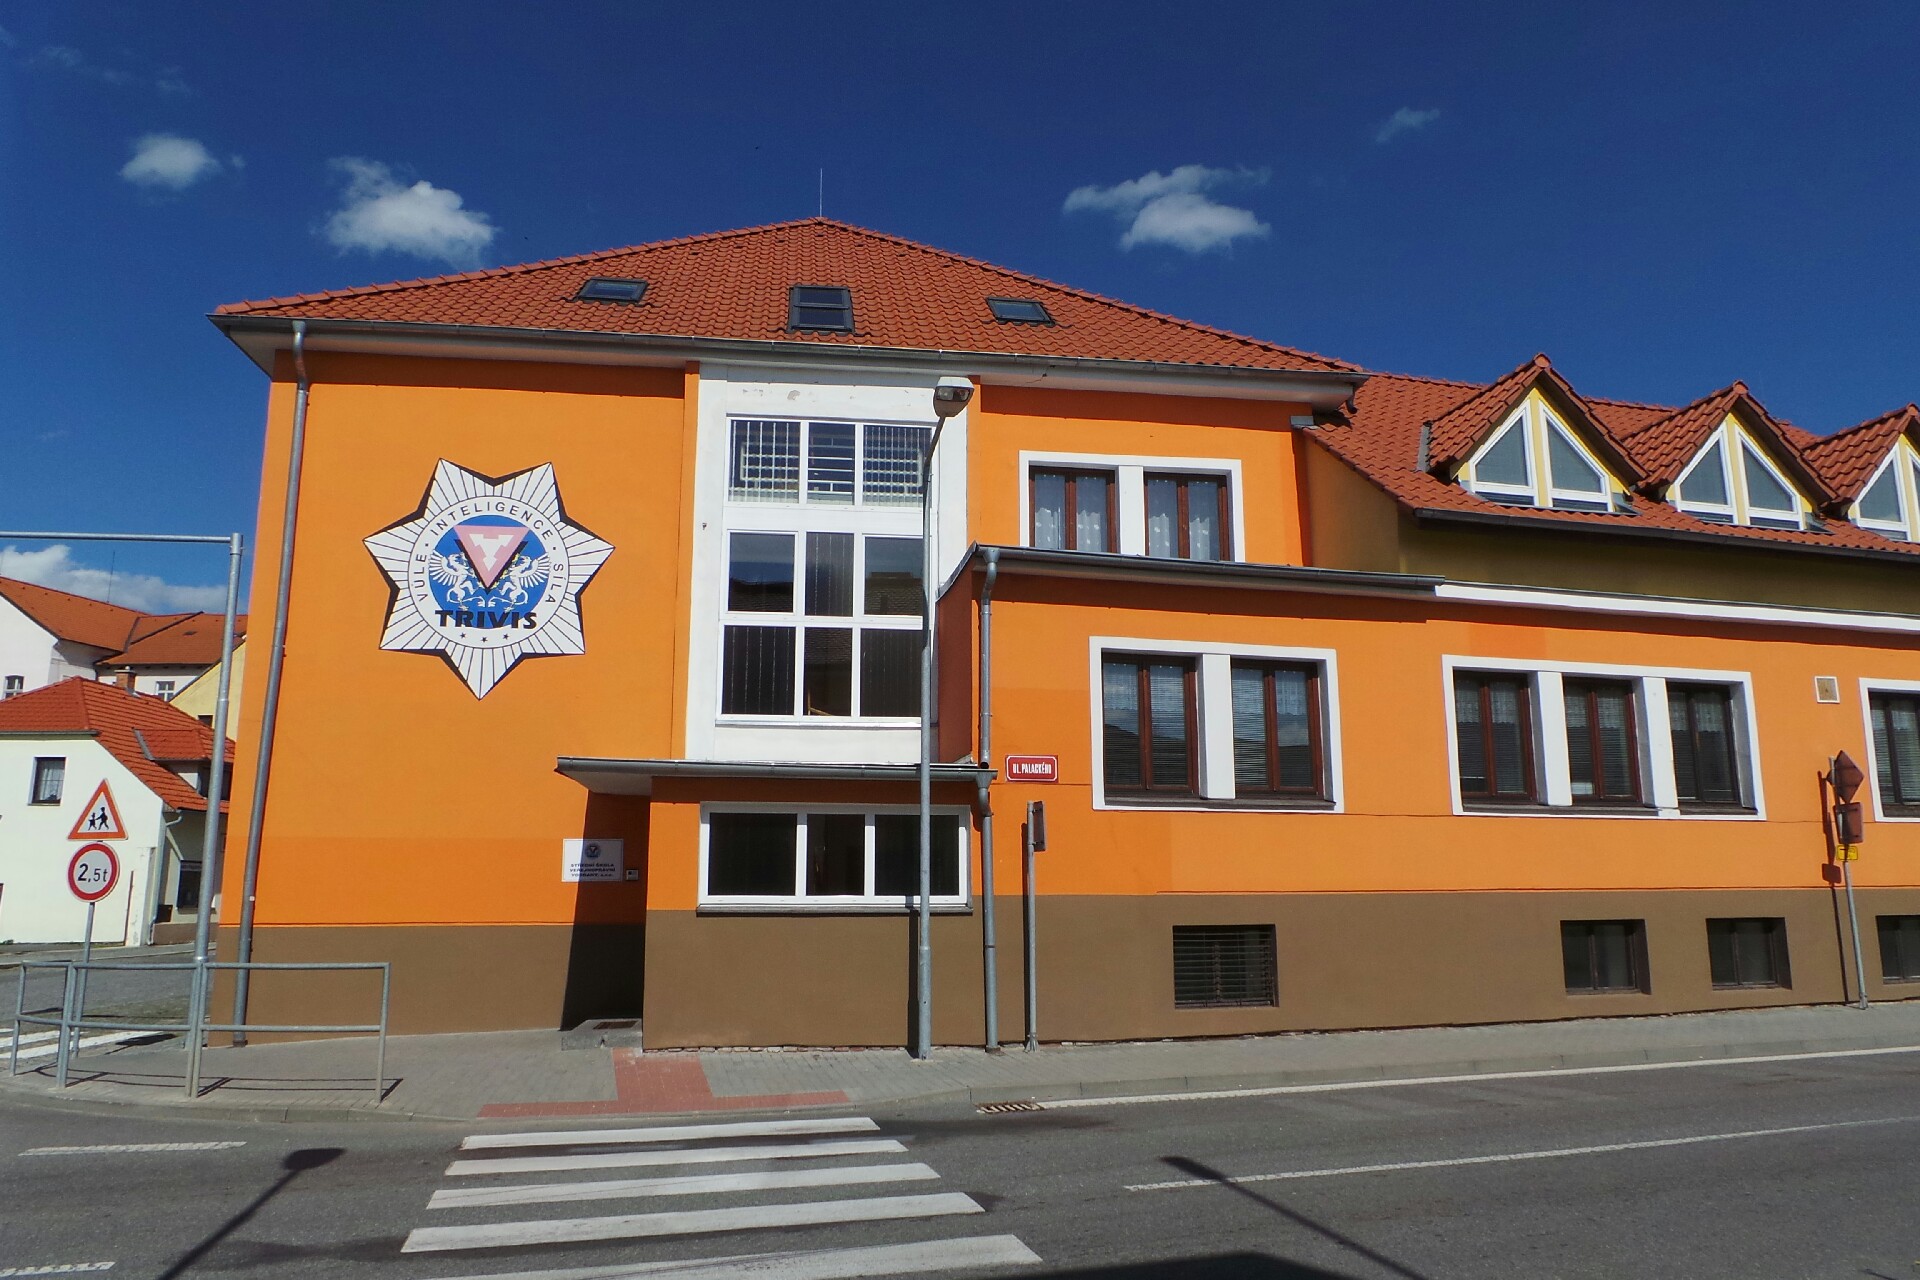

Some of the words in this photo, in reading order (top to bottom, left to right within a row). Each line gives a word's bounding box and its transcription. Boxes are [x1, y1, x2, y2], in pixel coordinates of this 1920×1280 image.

[430, 501, 554, 541] INTELIGENCE
[435, 610, 537, 629] TRIVIS
[1013, 764, 1021, 774] UL.
[1022, 762, 1052, 774] PALACKÉHO
